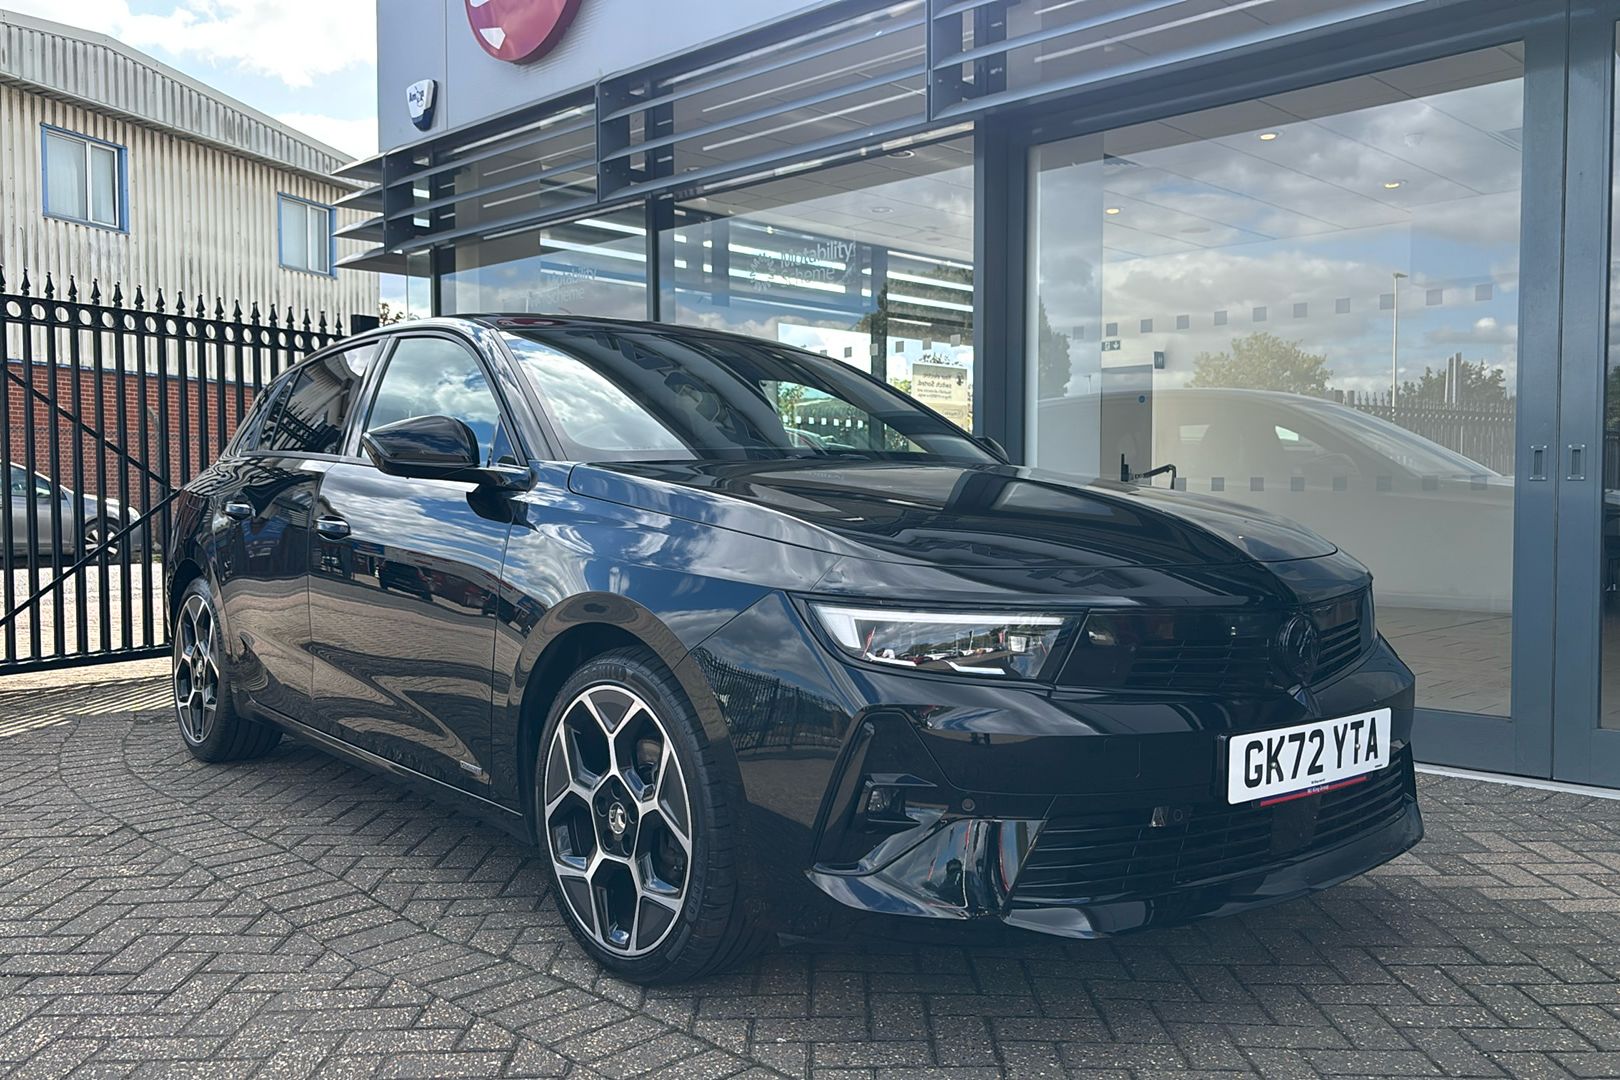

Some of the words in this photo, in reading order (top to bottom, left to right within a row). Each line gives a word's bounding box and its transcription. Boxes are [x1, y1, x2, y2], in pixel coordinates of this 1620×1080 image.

[781, 241, 852, 269] Motability
[1244, 728, 1325, 788] GK72
[1333, 717, 1379, 769] YTA
